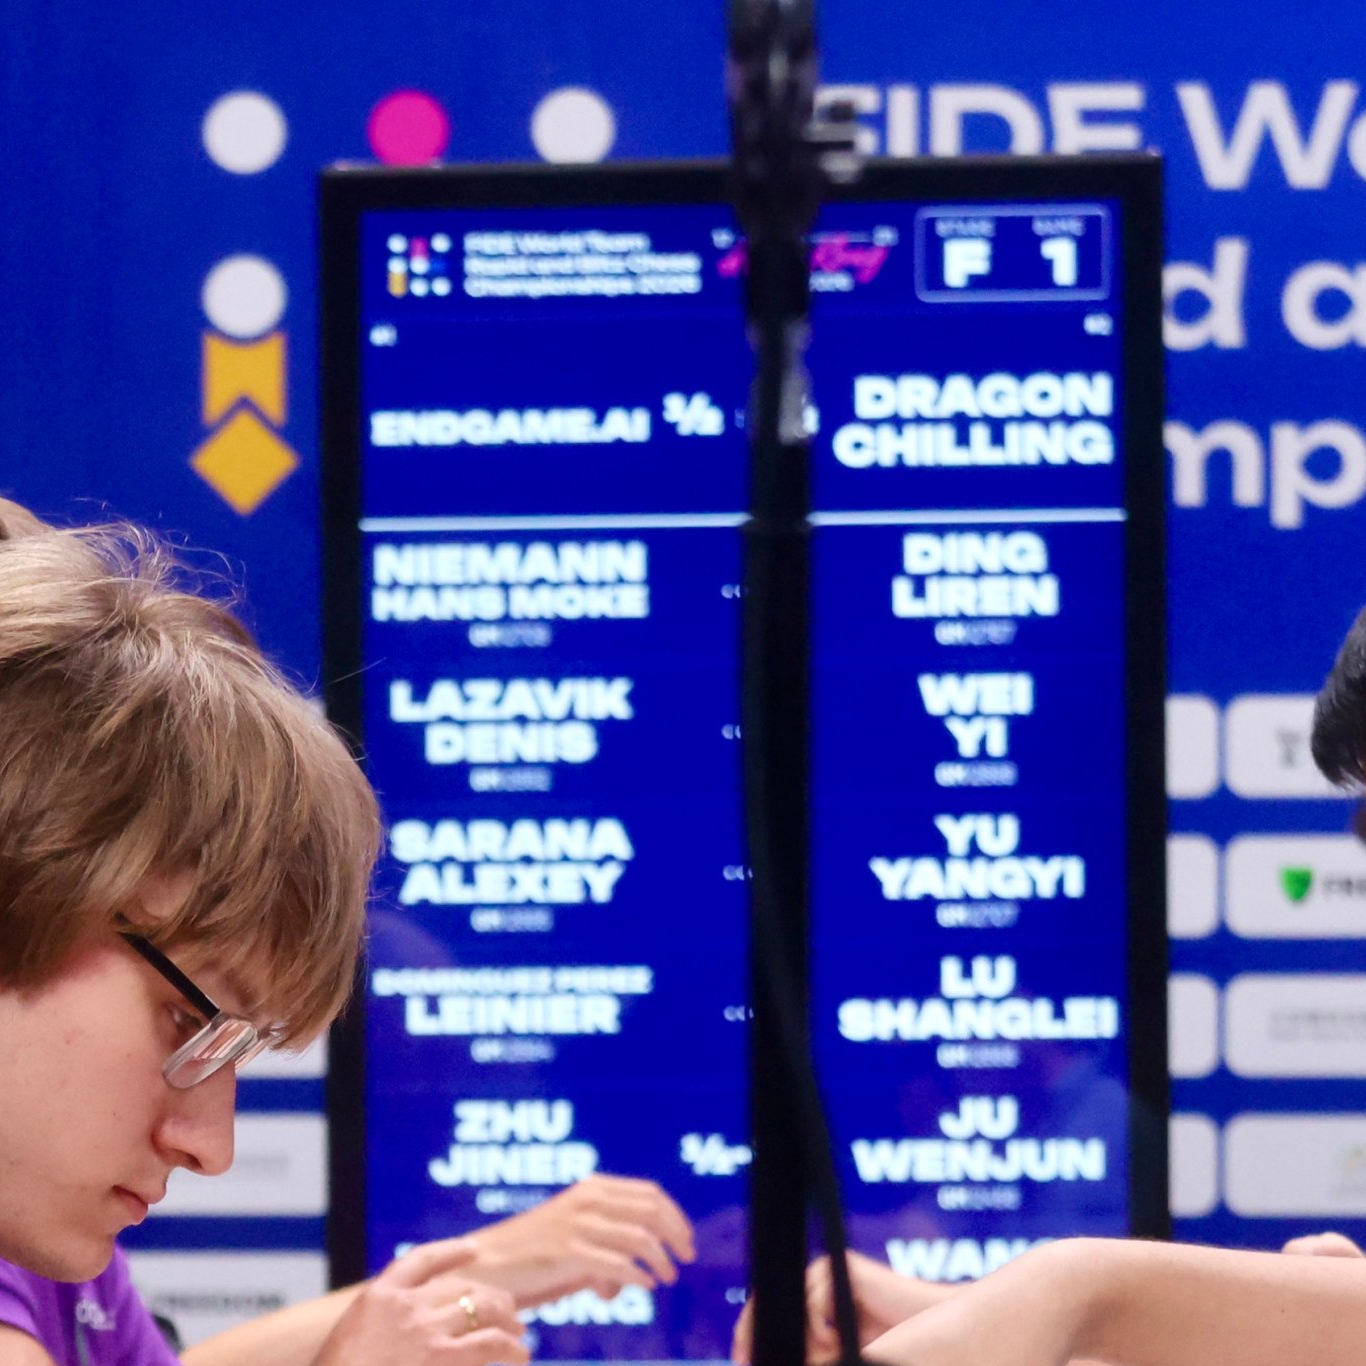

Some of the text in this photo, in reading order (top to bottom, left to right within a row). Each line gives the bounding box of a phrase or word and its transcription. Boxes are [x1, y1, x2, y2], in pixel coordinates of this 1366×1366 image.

[944, 238, 990, 287] F
[1041, 237, 1076, 285] 1
[855, 373, 1112, 419] DRAGON
[833, 421, 1113, 468] CHILLING
[374, 542, 646, 586] NIEMANN
[904, 532, 1047, 576] DING
[373, 586, 648, 622] HANS MOKE
[892, 576, 1059, 618] LIREN
[391, 679, 632, 721] LAZAVIK
[919, 674, 1032, 716] WEI
[425, 722, 597, 764] DENIS
[946, 716, 1007, 758] YI
[390, 819, 632, 862] SARANA
[935, 815, 1018, 856] YU
[399, 862, 623, 904] ALEXEY
[870, 857, 1084, 899] YANGYI
[939, 956, 1015, 998] LU
[405, 995, 620, 1035] LEINIER
[839, 998, 1118, 1041] SHANGLEI
[454, 1101, 572, 1142] ZHU
[939, 1097, 1017, 1140] JU
[429, 1142, 597, 1186] JINER
[853, 1138, 1105, 1182] WENJUN
[886, 1238, 1055, 1281] WAN
